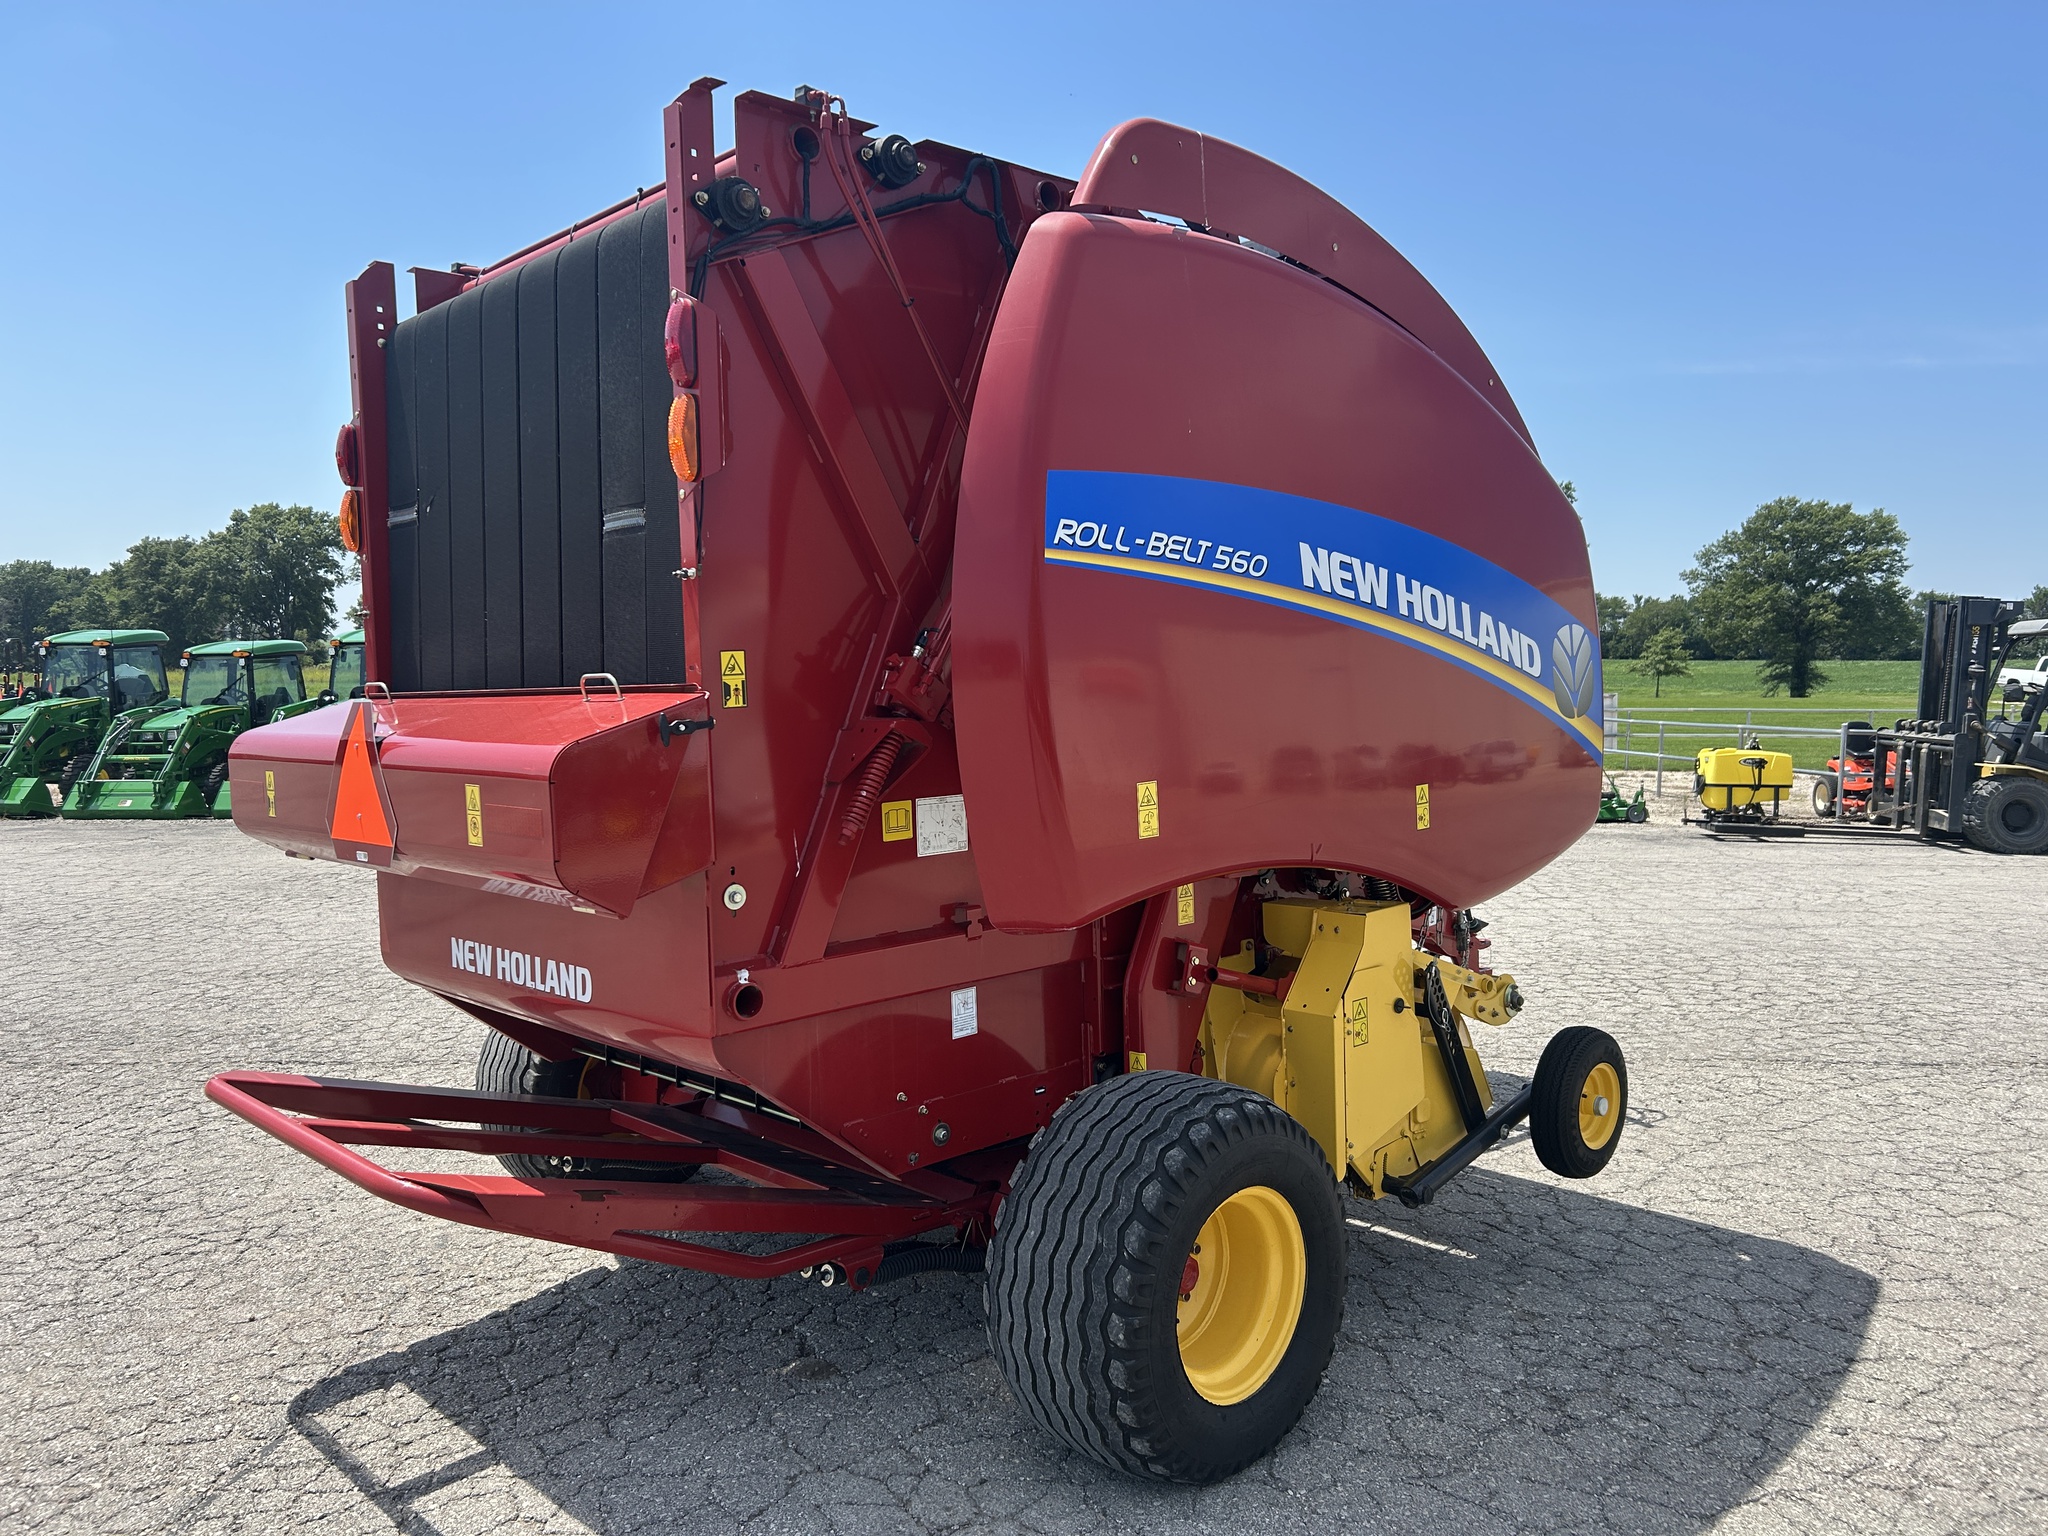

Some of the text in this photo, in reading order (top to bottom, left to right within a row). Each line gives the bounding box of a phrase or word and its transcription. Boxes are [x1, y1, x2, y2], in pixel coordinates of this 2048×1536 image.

[1053, 518, 1268, 577] ROLL-BELT 560
[1299, 541, 1541, 678] NEW HOLLAND
[451, 936, 592, 1003] NEW HOLLAND
